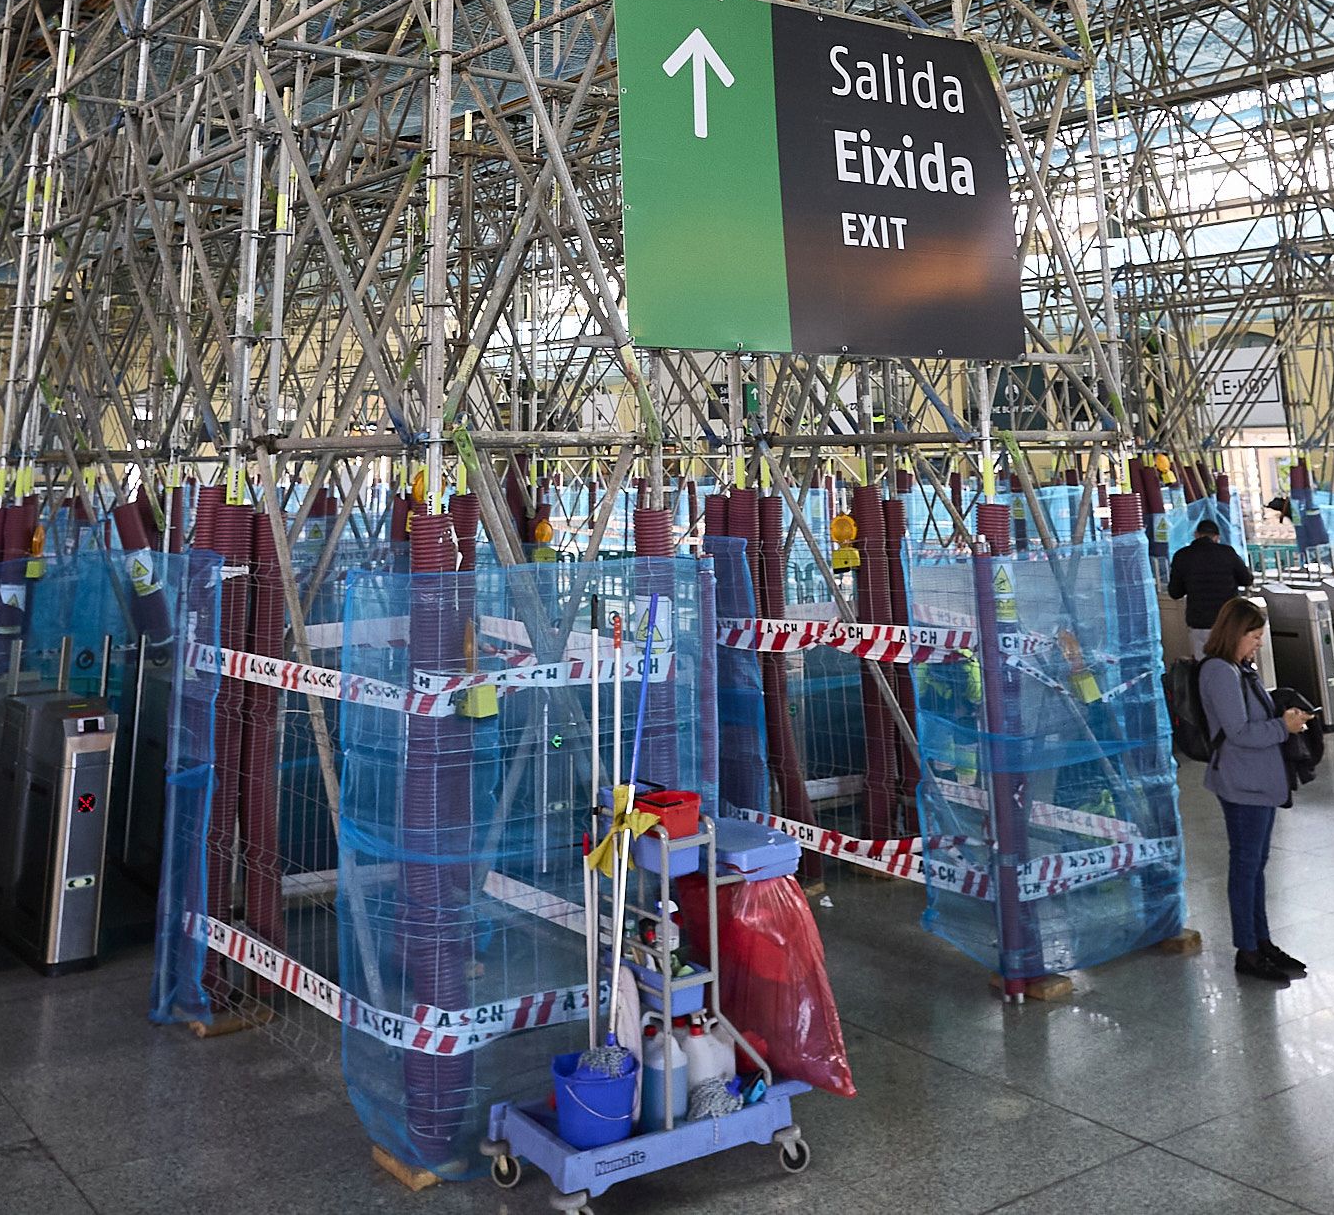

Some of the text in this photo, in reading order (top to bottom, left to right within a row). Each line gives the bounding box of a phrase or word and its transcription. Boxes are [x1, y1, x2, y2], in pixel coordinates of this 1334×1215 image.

[829, 45, 965, 114] Salida
[833, 128, 976, 196] Eixida
[841, 212, 907, 250] EXIT
[829, 626, 864, 639] ASCH
[900, 629, 937, 645] ASCH
[250, 658, 278, 677] ASCH
[303, 670, 335, 688] ASCH
[780, 821, 814, 842] ASCH
[249, 943, 277, 973] ASCH
[303, 972, 333, 1005] ASCH
[363, 1008, 403, 1040] ASCH
[437, 1004, 504, 1028] ASCH
[595, 1150, 646, 1177] Numatic
